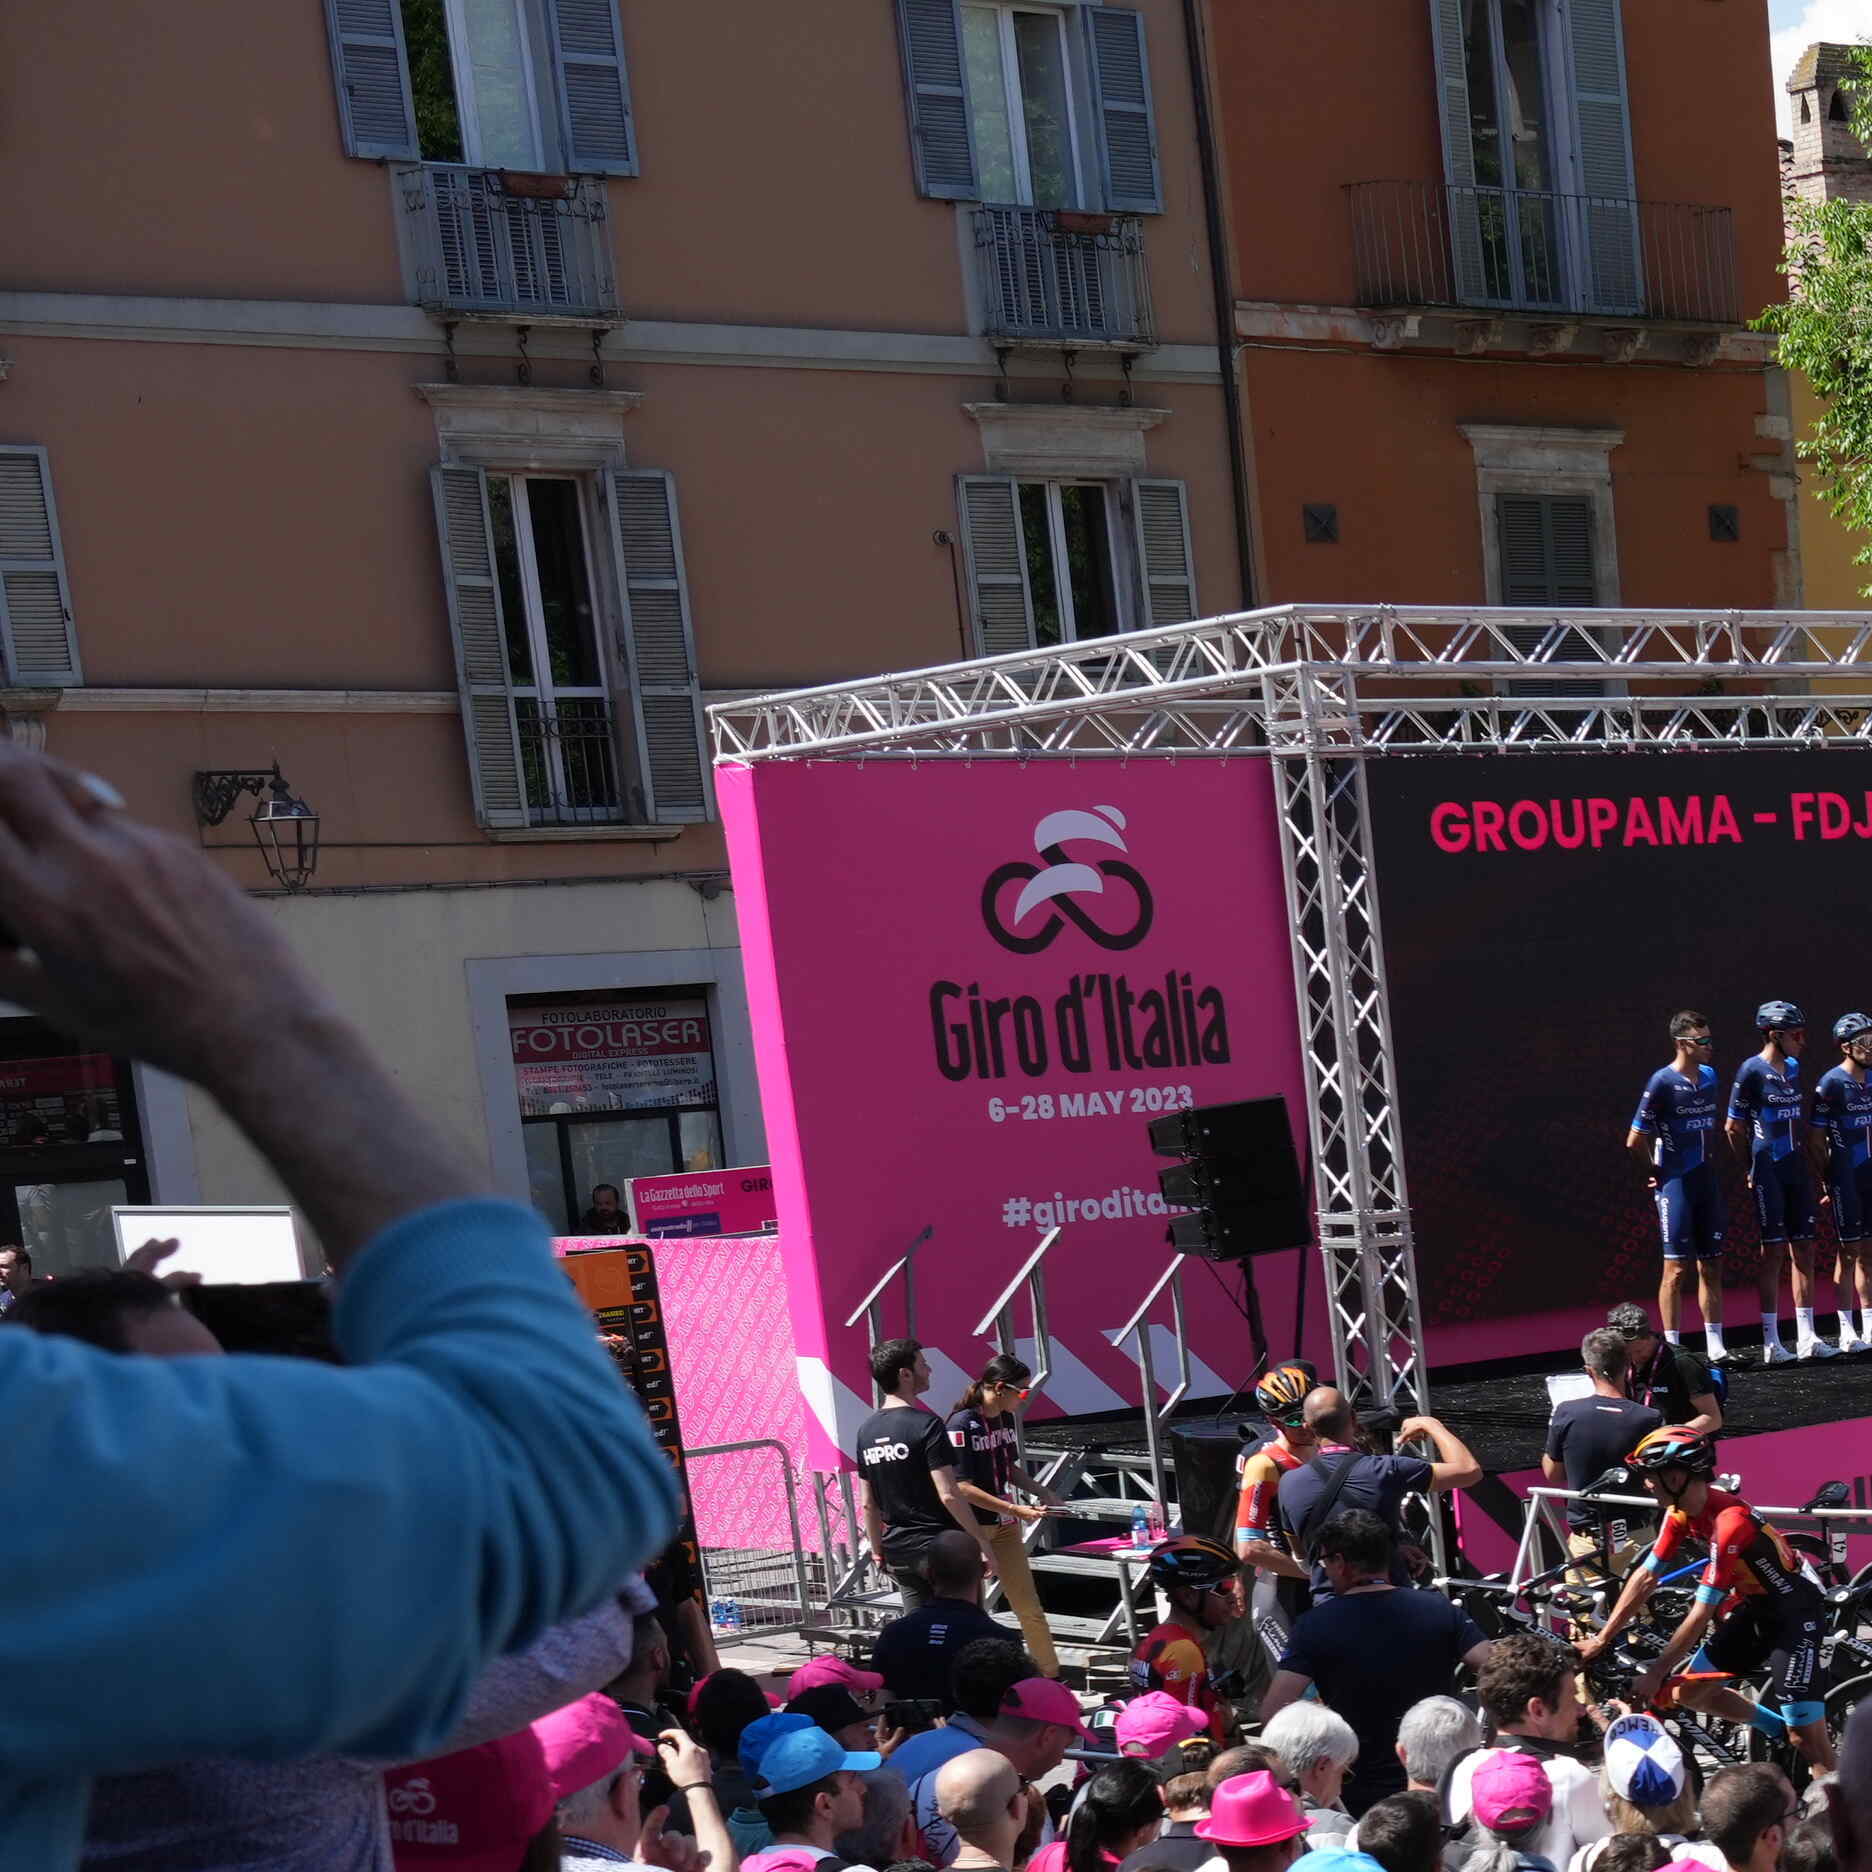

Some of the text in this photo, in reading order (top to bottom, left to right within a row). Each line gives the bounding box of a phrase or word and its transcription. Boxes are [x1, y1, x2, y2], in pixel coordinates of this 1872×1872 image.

[1427, 792, 1744, 855] GROUPAMA
[541, 1007, 667, 1025] FOTOLABORATORIO
[929, 969, 1232, 1082] Giro d'Italia
[511, 1019, 701, 1054] FOTOLASER
[523, 1065, 560, 1075] STAMPE
[561, 1061, 627, 1073] FOTOGRAFICHE
[572, 1048, 649, 1060] DIGITAL EXPRESS
[987, 1084, 1196, 1125] 6-28 MAY 2023
[650, 1187, 684, 1202] Gazzetta
[684, 1184, 702, 1199] dello
[703, 1182, 725, 1199] Sport
[1002, 1185, 1204, 1234] #girodita
[863, 1442, 910, 1467] HiPRO
[1611, 1519, 1628, 1545] 109
[1755, 1557, 1794, 1595] BAHRAIN
